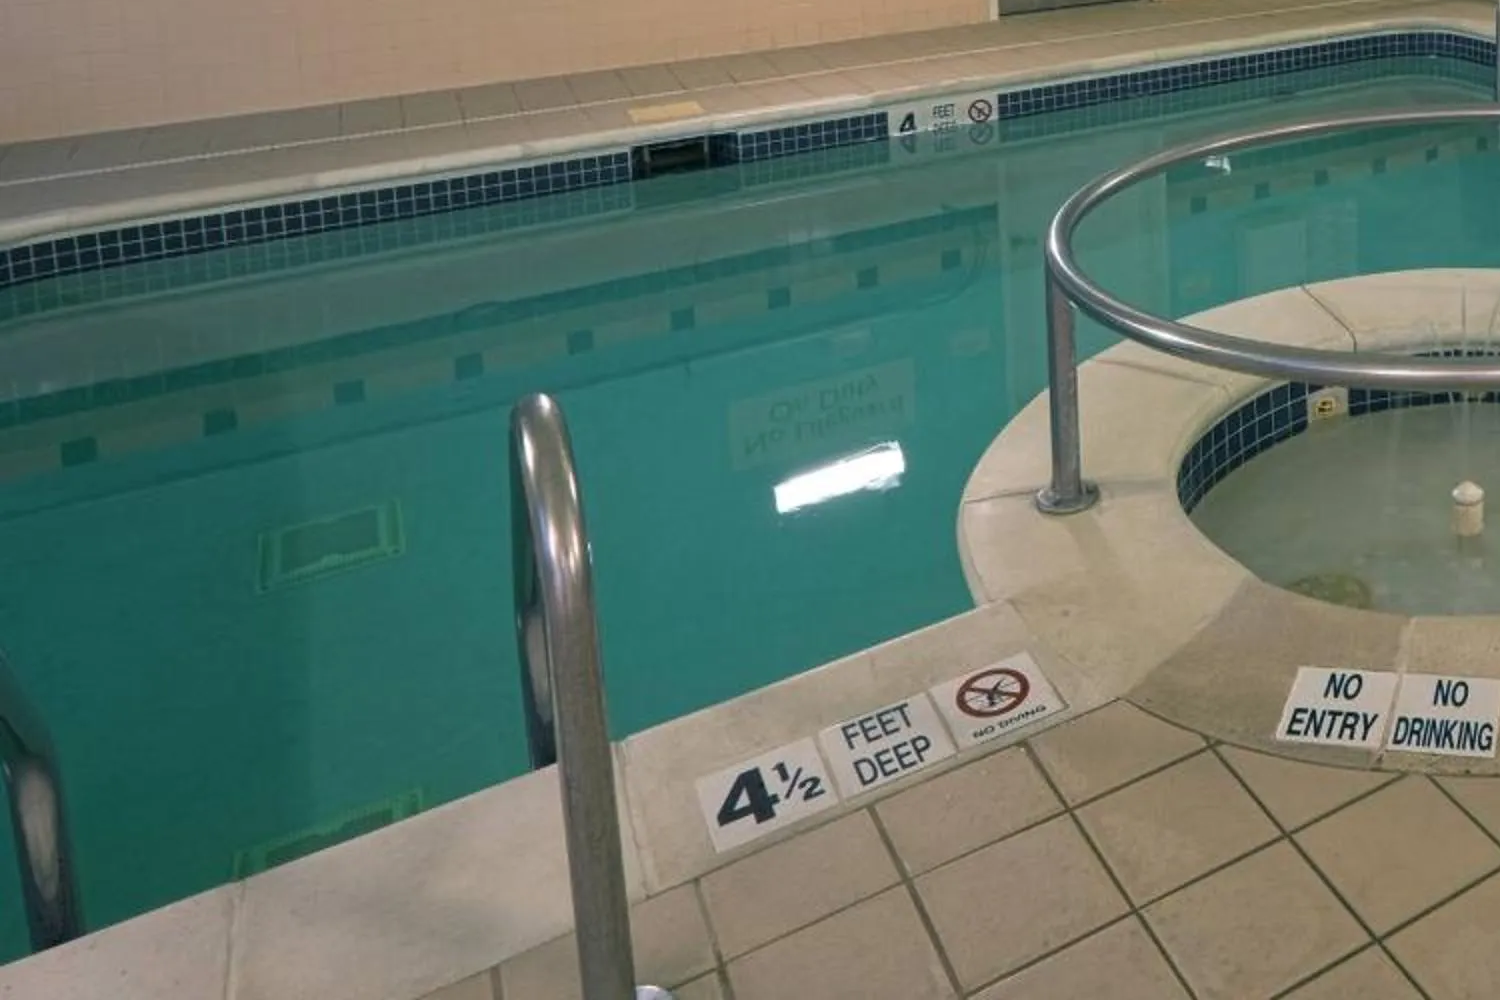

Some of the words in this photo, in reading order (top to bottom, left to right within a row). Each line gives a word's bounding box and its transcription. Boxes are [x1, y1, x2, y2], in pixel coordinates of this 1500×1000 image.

[1323, 673, 1363, 700] NO
[1433, 679, 1469, 707] NO
[841, 702, 914, 750] FEET
[973, 725, 995, 738] NO
[997, 704, 1046, 728] DIVING
[1286, 708, 1379, 741] ENTRY
[1392, 716, 1493, 751] DRINKING
[853, 735, 932, 786] DEEP
